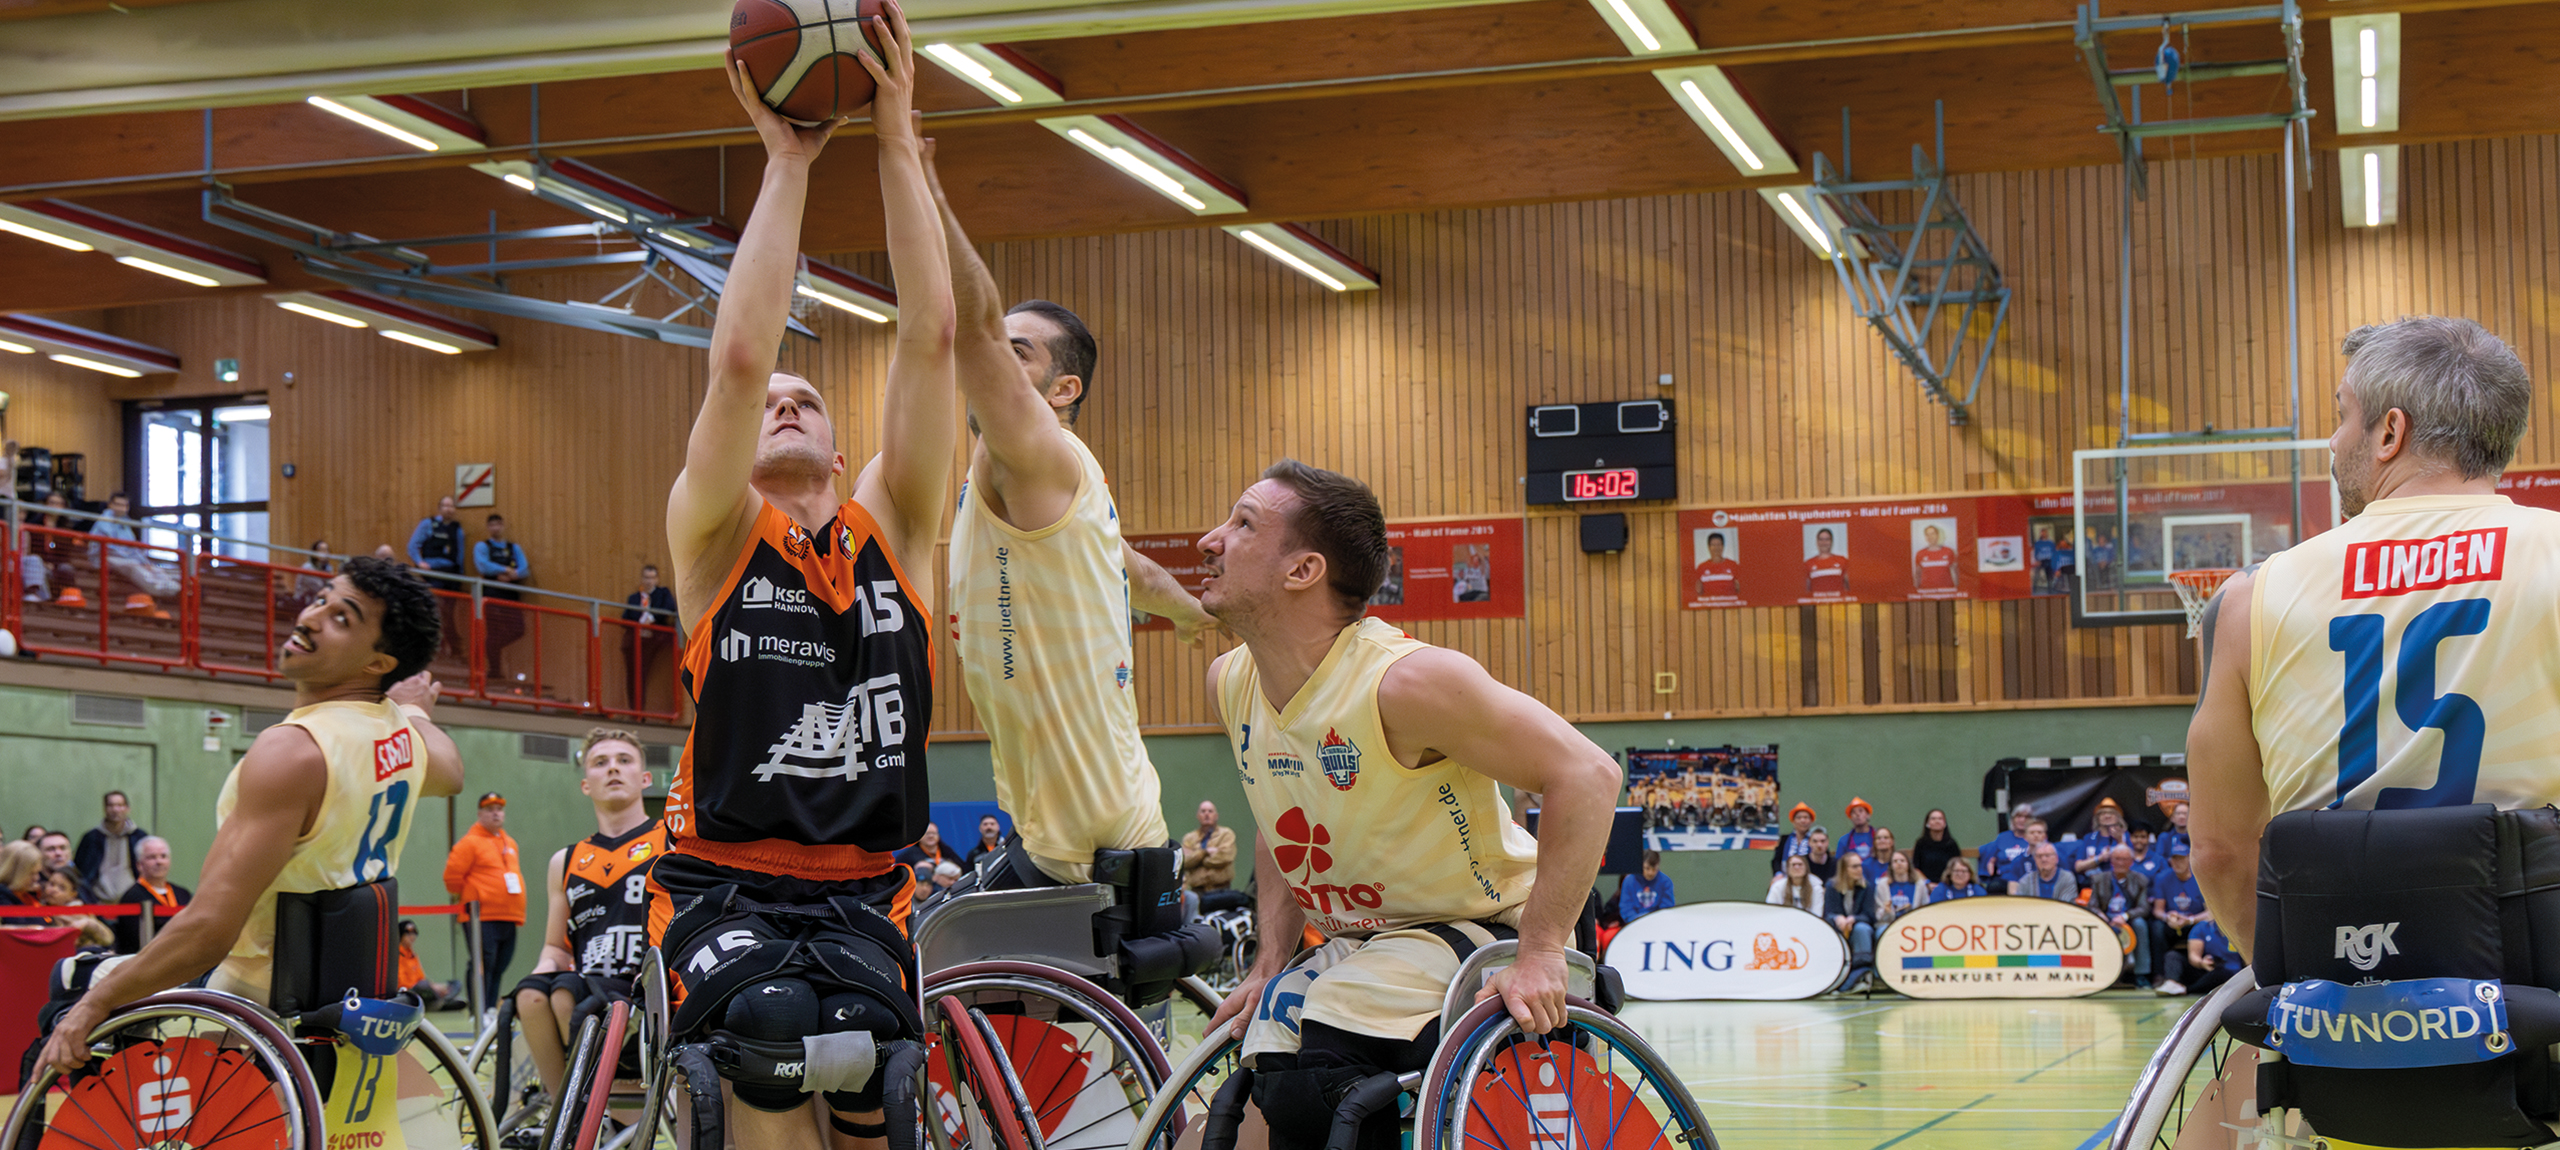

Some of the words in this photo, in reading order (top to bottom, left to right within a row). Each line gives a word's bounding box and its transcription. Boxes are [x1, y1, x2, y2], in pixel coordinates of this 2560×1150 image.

[1574, 470, 1637, 498] 16:02
[1412, 528, 1432, 538] Hall
[1432, 527, 1444, 537] of
[1444, 526, 1470, 536] Fame
[1470, 525, 1495, 536] 2015
[2353, 531, 2497, 593] LINDEN
[774, 586, 806, 604] KSG
[855, 579, 905, 638] 15
[995, 546, 1017, 681] www.juettner.de
[757, 652, 826, 669] Immobiliengruppe
[758, 634, 836, 664] meravis
[2326, 597, 2492, 814] 15
[1321, 754, 1356, 772] BULLS
[623, 874, 647, 905] 8
[1899, 924, 2099, 954] SPORTSTADT
[1639, 939, 1736, 972] ING
[1900, 972, 2004, 985] FRANKFURT
[2013, 972, 2039, 982] AM
[2047, 971, 2095, 983] MAIN
[339, 1130, 384, 1150] LOTTO
